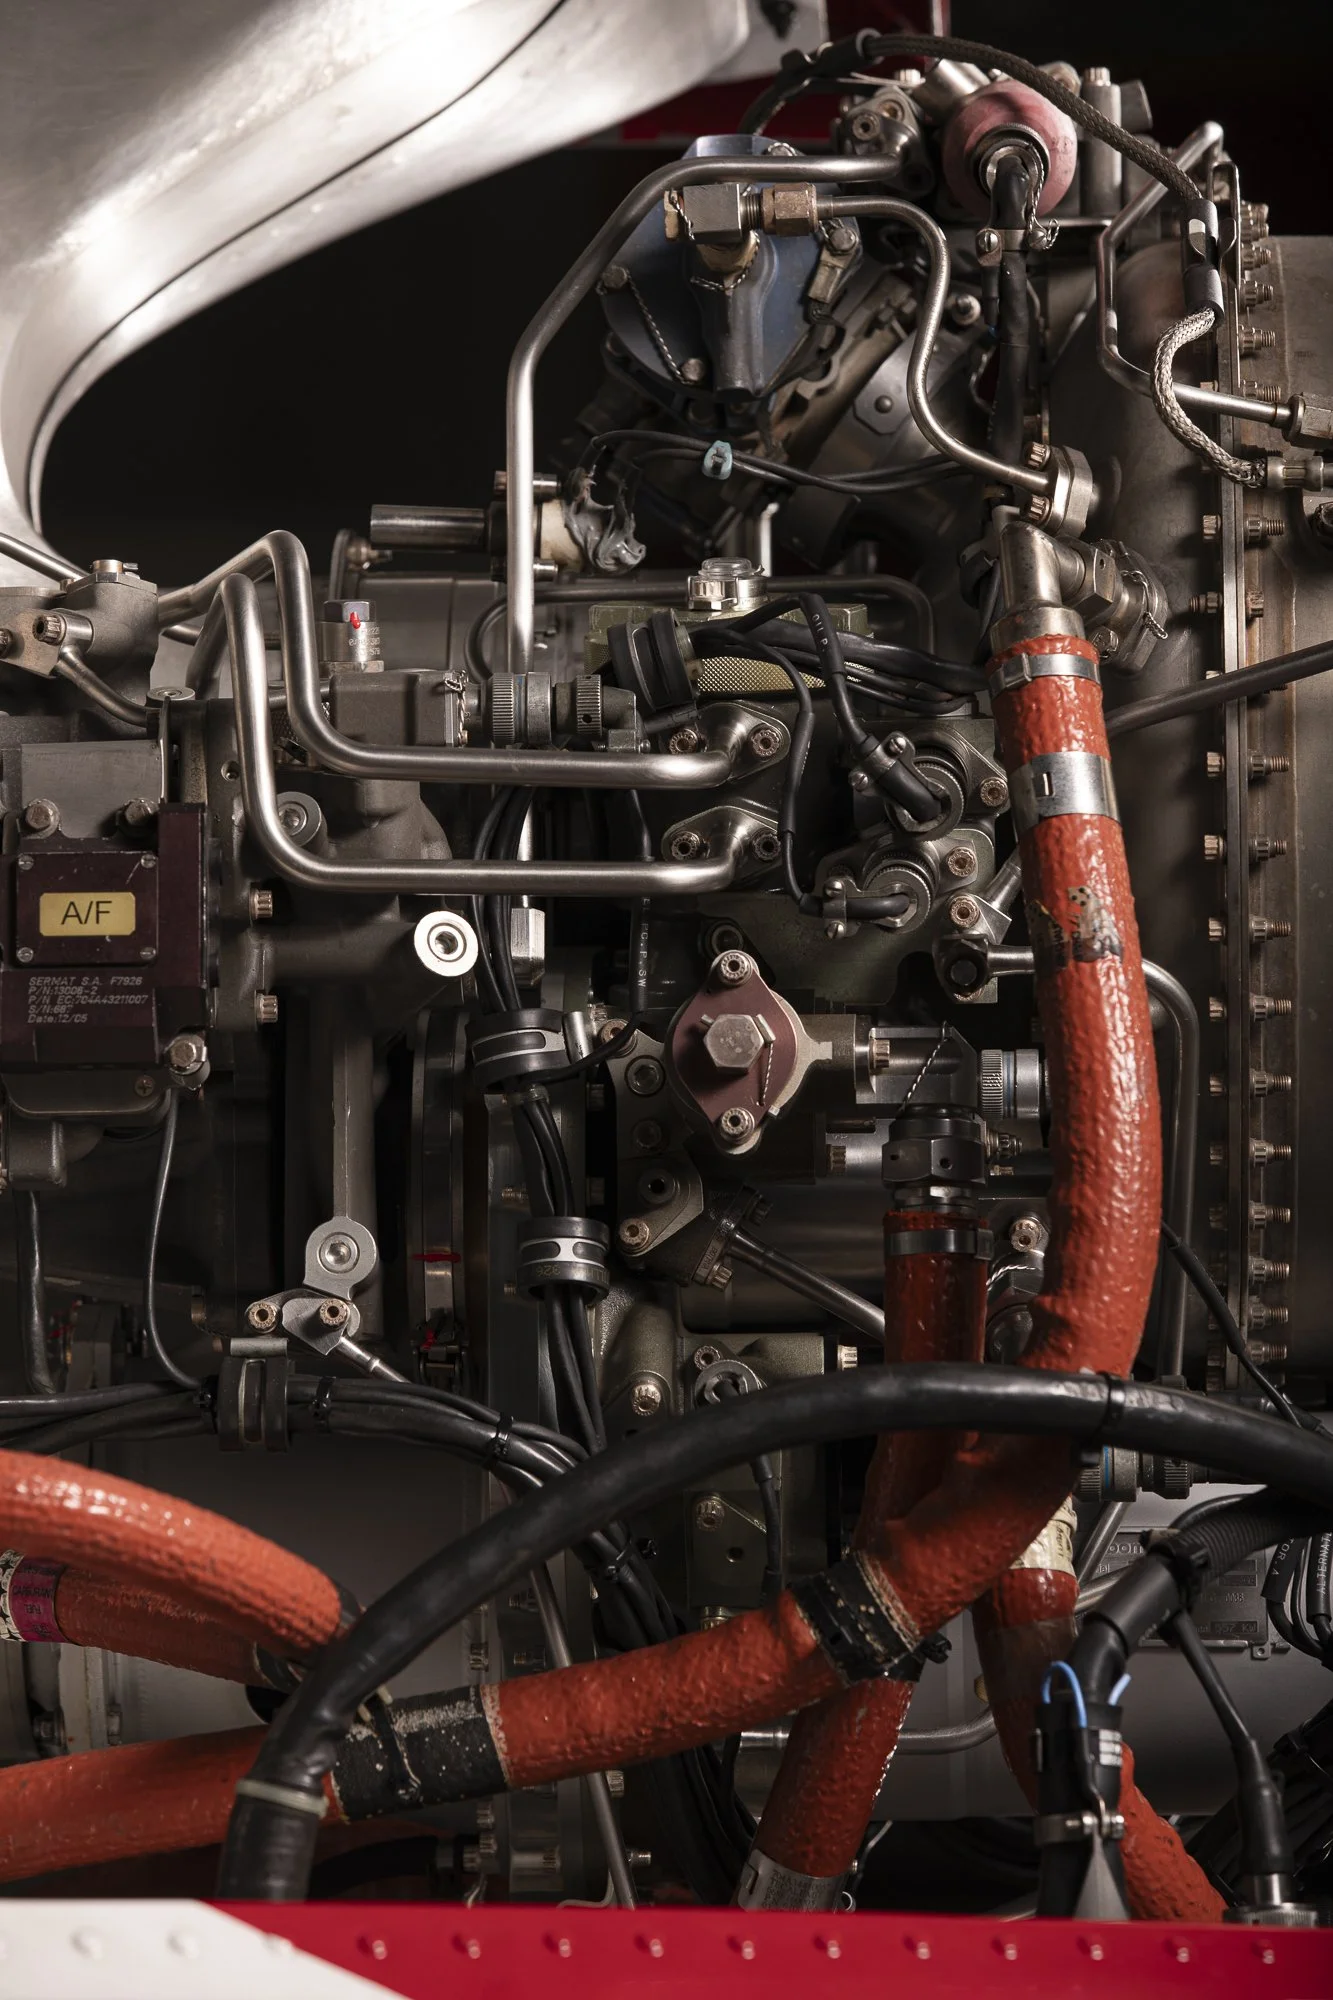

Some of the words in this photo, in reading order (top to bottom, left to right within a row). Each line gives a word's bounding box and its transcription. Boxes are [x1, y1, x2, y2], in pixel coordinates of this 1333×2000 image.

[60, 900, 113, 925] A/F
[28, 976, 76, 986] SERMAT
[27, 995, 50, 1005] P/N
